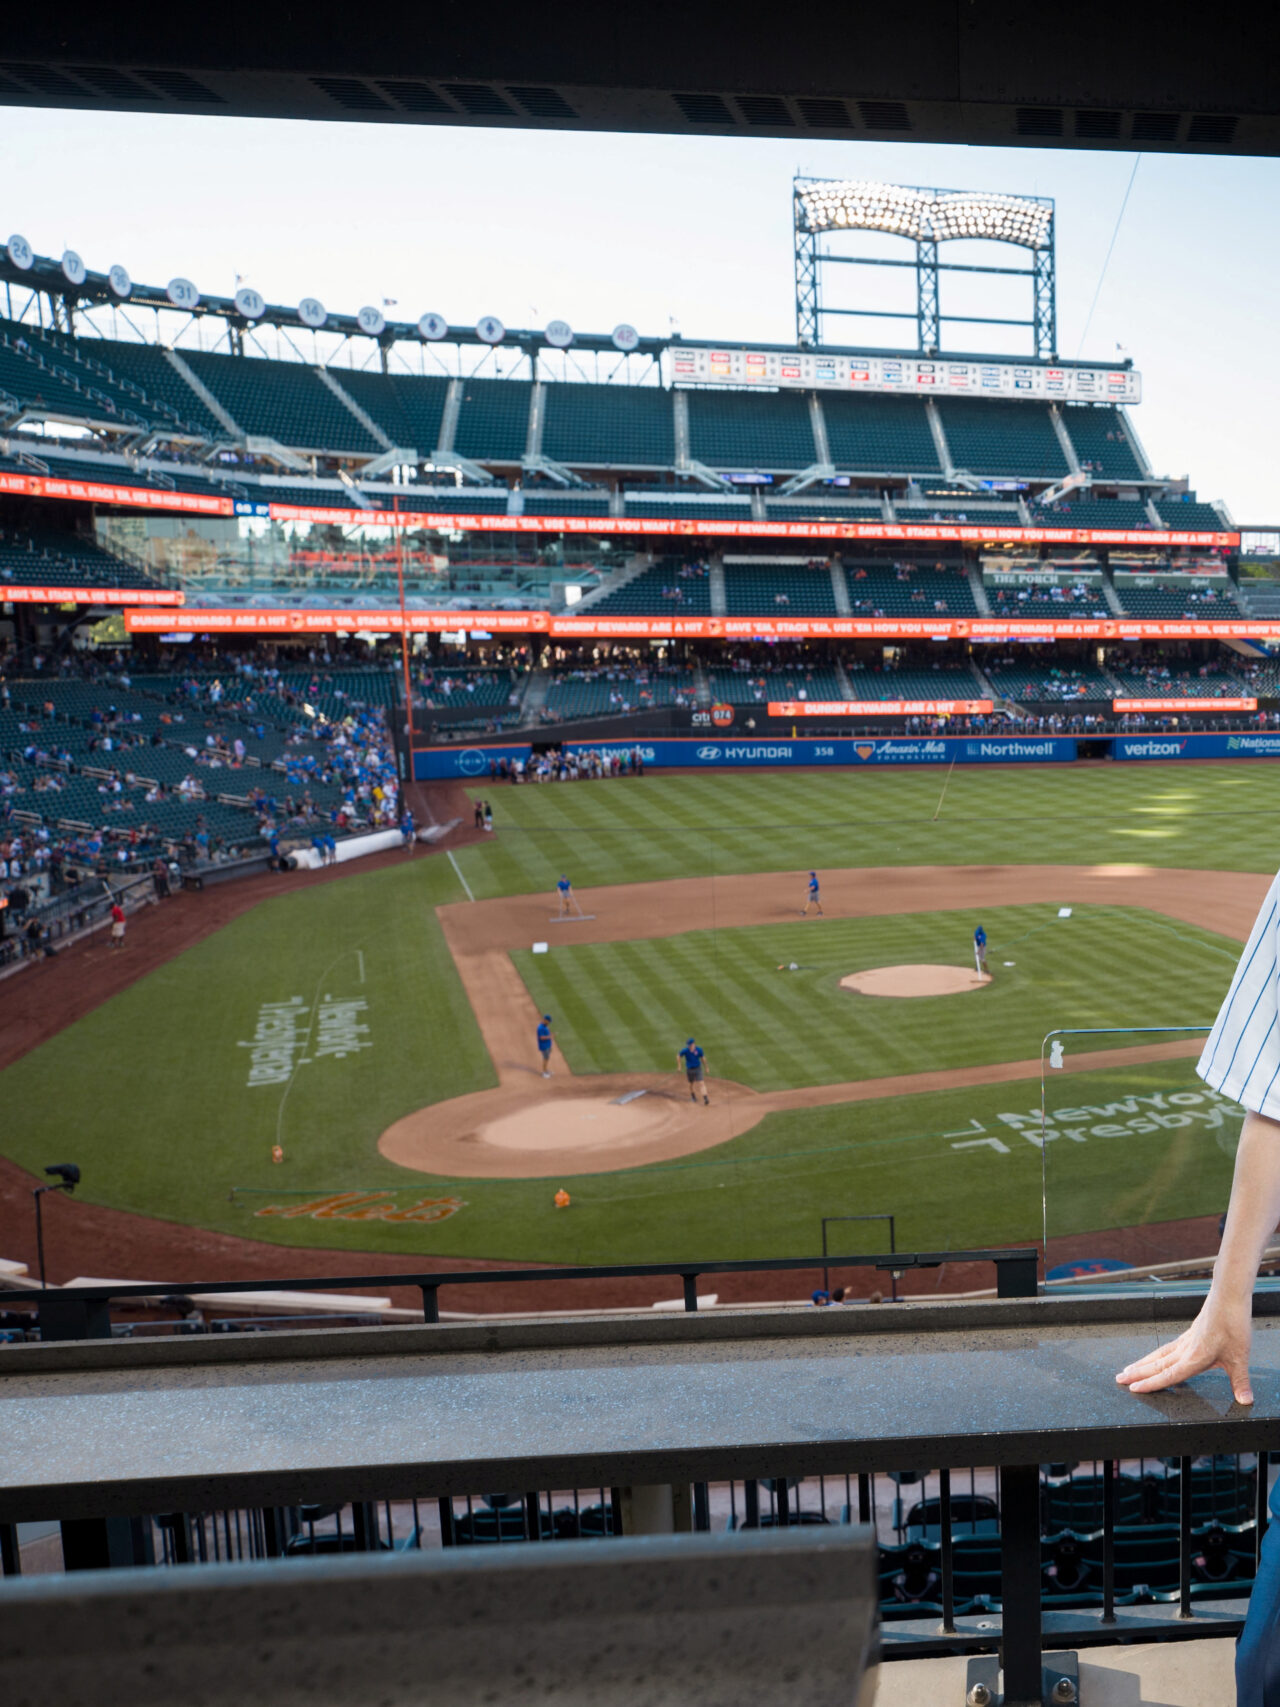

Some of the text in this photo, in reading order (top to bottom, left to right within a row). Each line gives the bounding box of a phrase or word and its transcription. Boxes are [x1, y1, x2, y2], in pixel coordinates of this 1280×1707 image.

[13, 242, 28, 259] 24
[176, 286, 192, 300] 31
[243, 296, 258, 310] 41
[306, 306, 319, 318] 14
[362, 313, 378, 326] 37
[617, 330, 634, 342] 42
[994, 575, 1016, 584] THE
[1018, 575, 1058, 584] PORCH
[177, 615, 233, 626] REWARDS
[235, 615, 256, 626] ARE
[258, 616, 266, 626] A
[268, 616, 287, 626] HIT
[597, 622, 650, 633] REWARDS
[651, 622, 673, 633] ARE
[674, 622, 683, 632] A
[685, 622, 703, 632] HIT
[848, 703, 902, 714] REWARDS
[903, 702, 925, 713] ARE
[926, 702, 935, 712] A
[937, 702, 955, 712] HIT
[692, 711, 710, 722] citi
[726, 747, 792, 758] HYUNDAI
[814, 747, 834, 756] 358
[877, 741, 946, 754] Amazin' Mets
[981, 742, 1054, 755] Northwell
[1124, 741, 1180, 756] verizon
[996, 1088, 1226, 1130] NewYor
[254, 1191, 469, 1224] Mets
